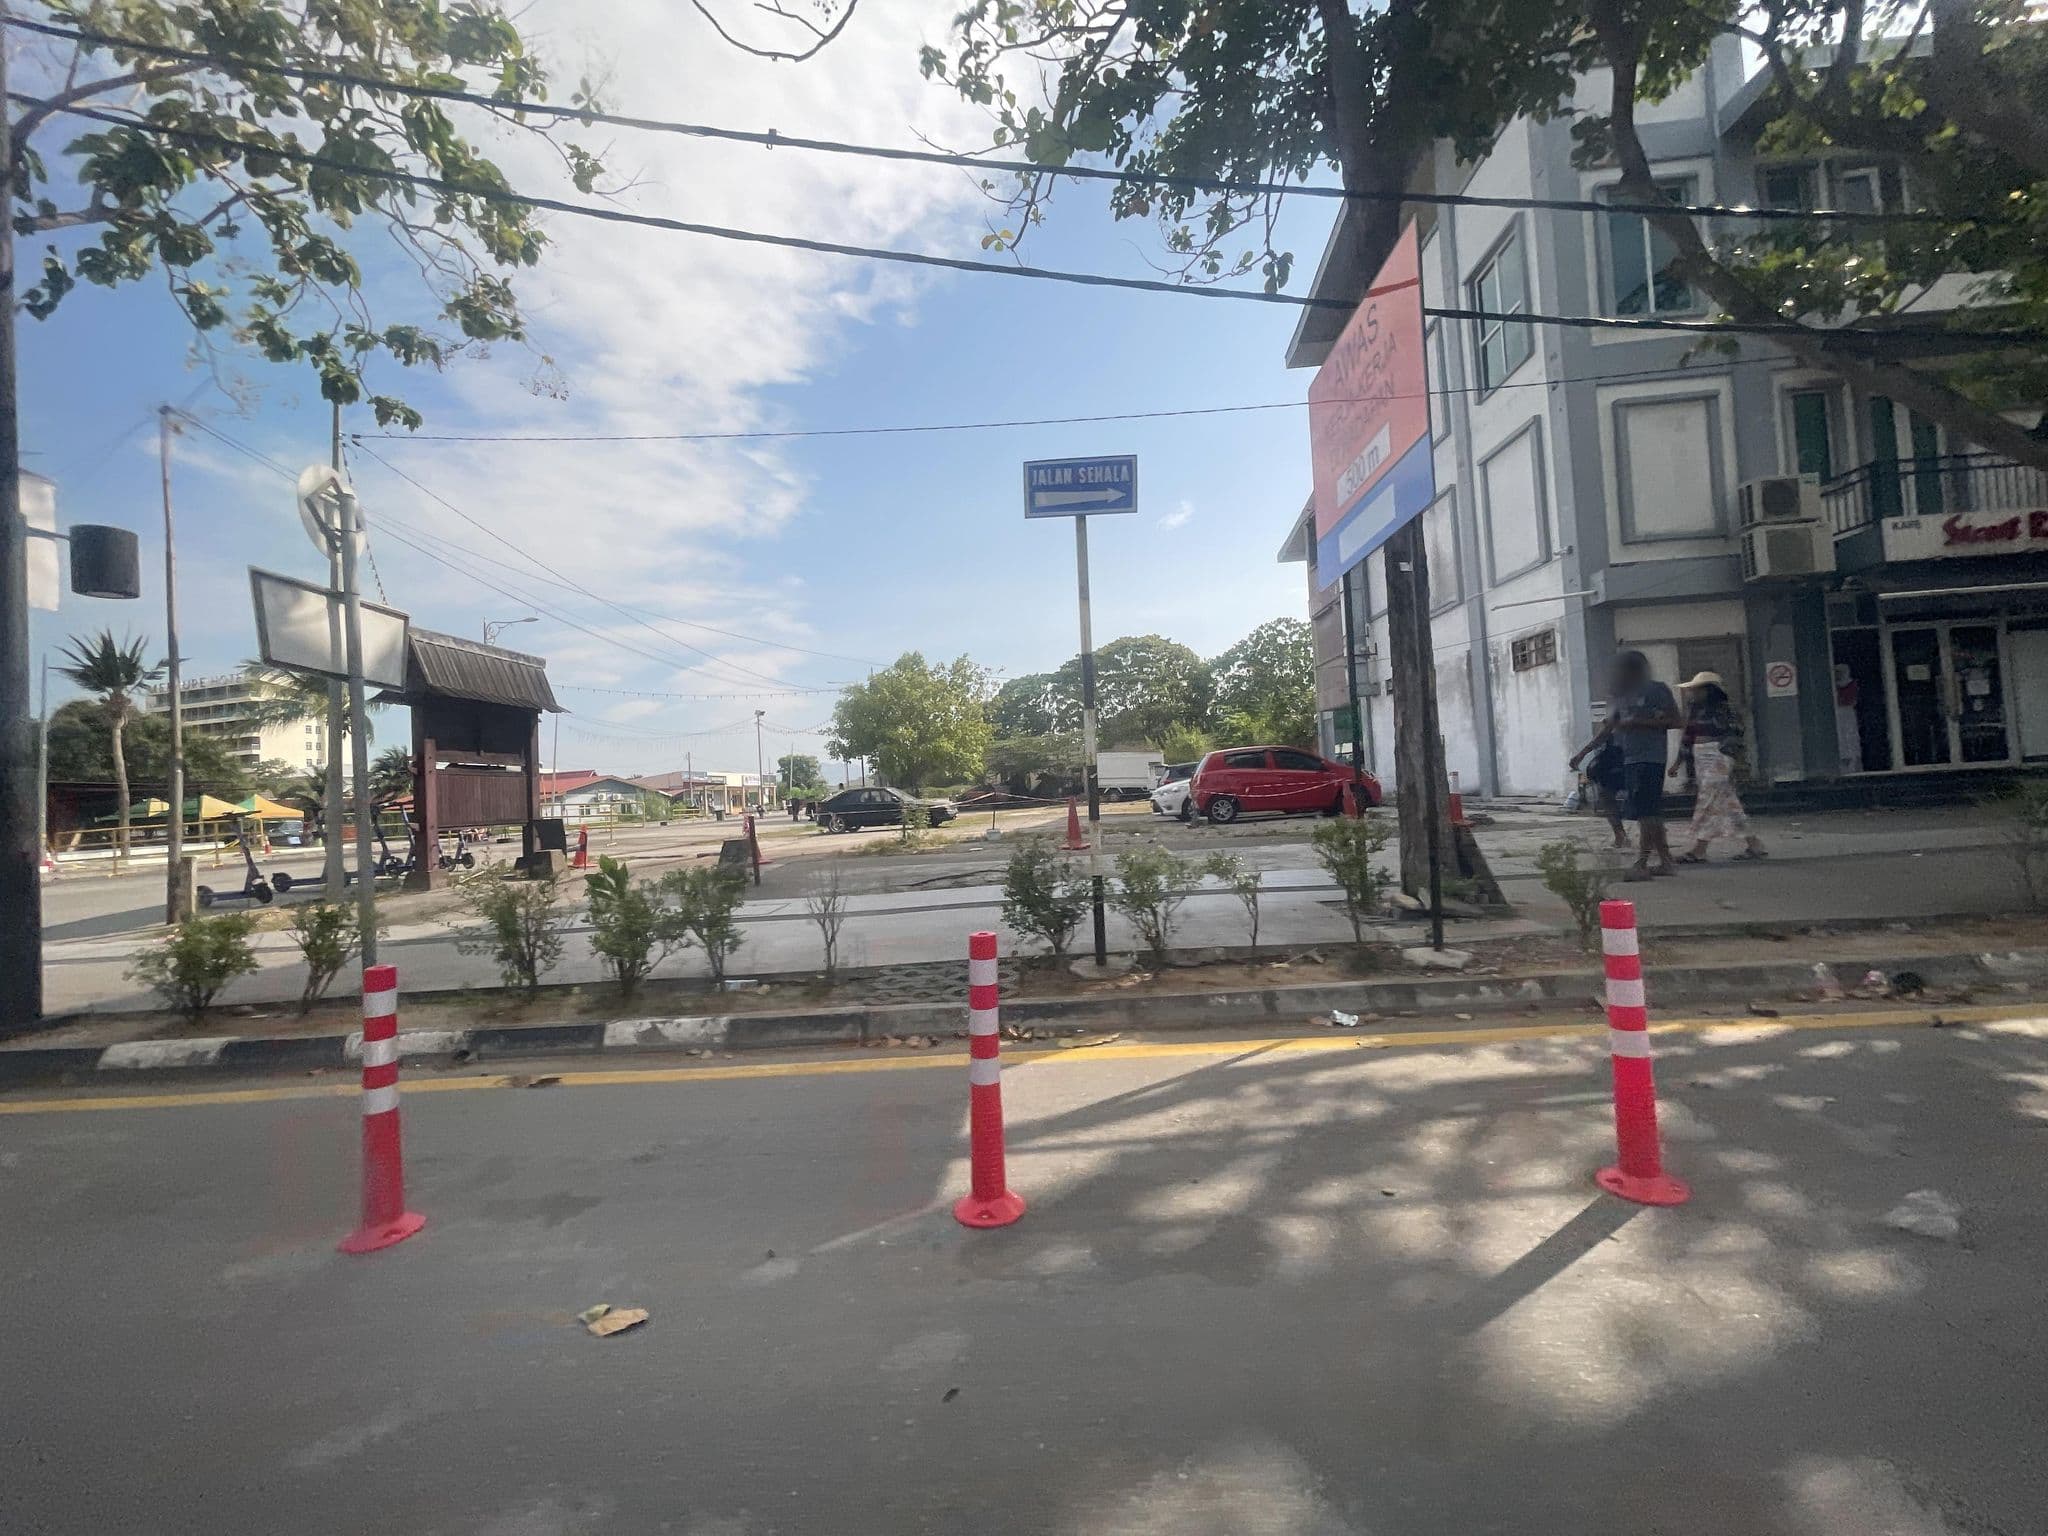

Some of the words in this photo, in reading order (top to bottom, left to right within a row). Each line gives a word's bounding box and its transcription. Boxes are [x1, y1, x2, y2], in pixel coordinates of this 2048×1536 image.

[1336, 303, 1379, 387] AWAS
[1031, 467, 1073, 486] JALAN
[1078, 464, 1131, 484] SEHALA
